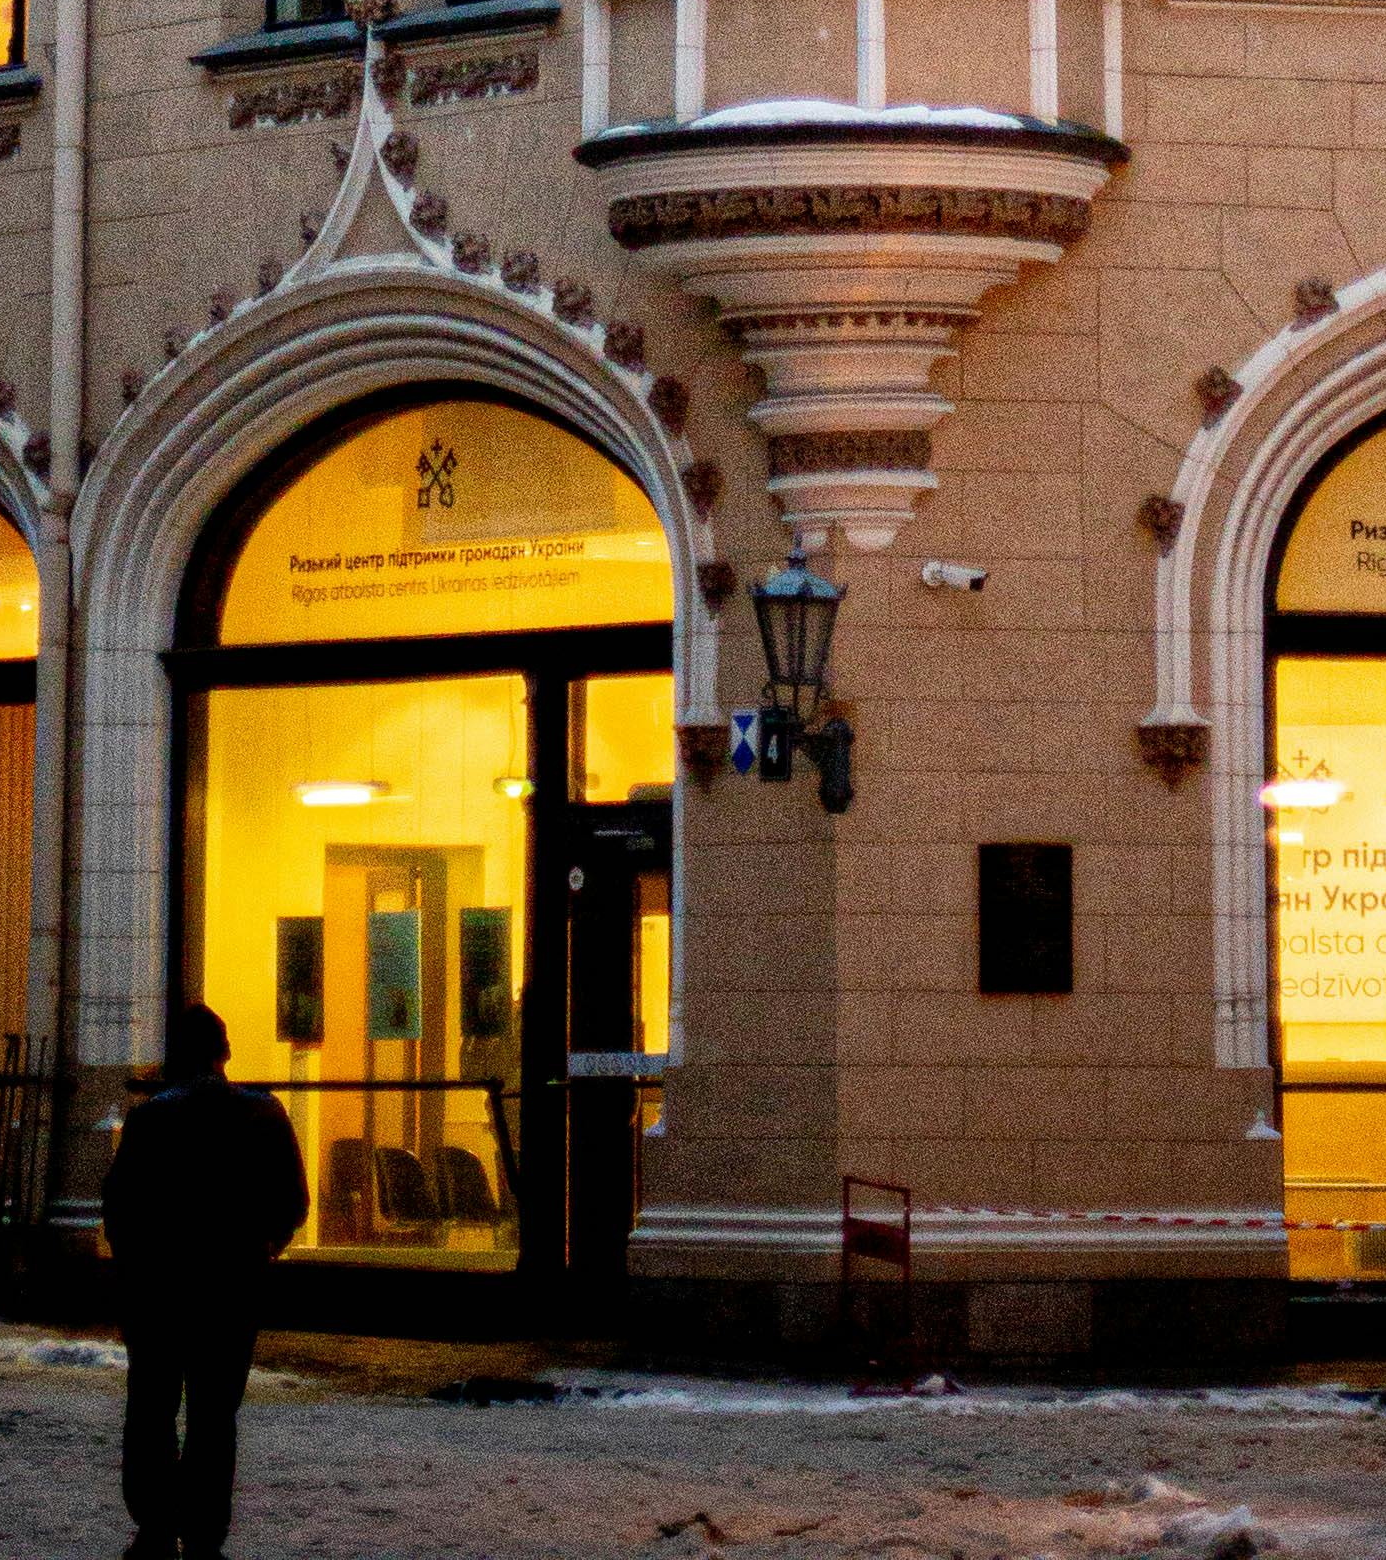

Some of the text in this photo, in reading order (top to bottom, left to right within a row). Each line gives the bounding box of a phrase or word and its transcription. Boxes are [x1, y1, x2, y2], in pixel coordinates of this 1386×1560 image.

[289, 537, 585, 574] Ризький центр підтримки громадян України
[767, 733, 779, 764] 4
